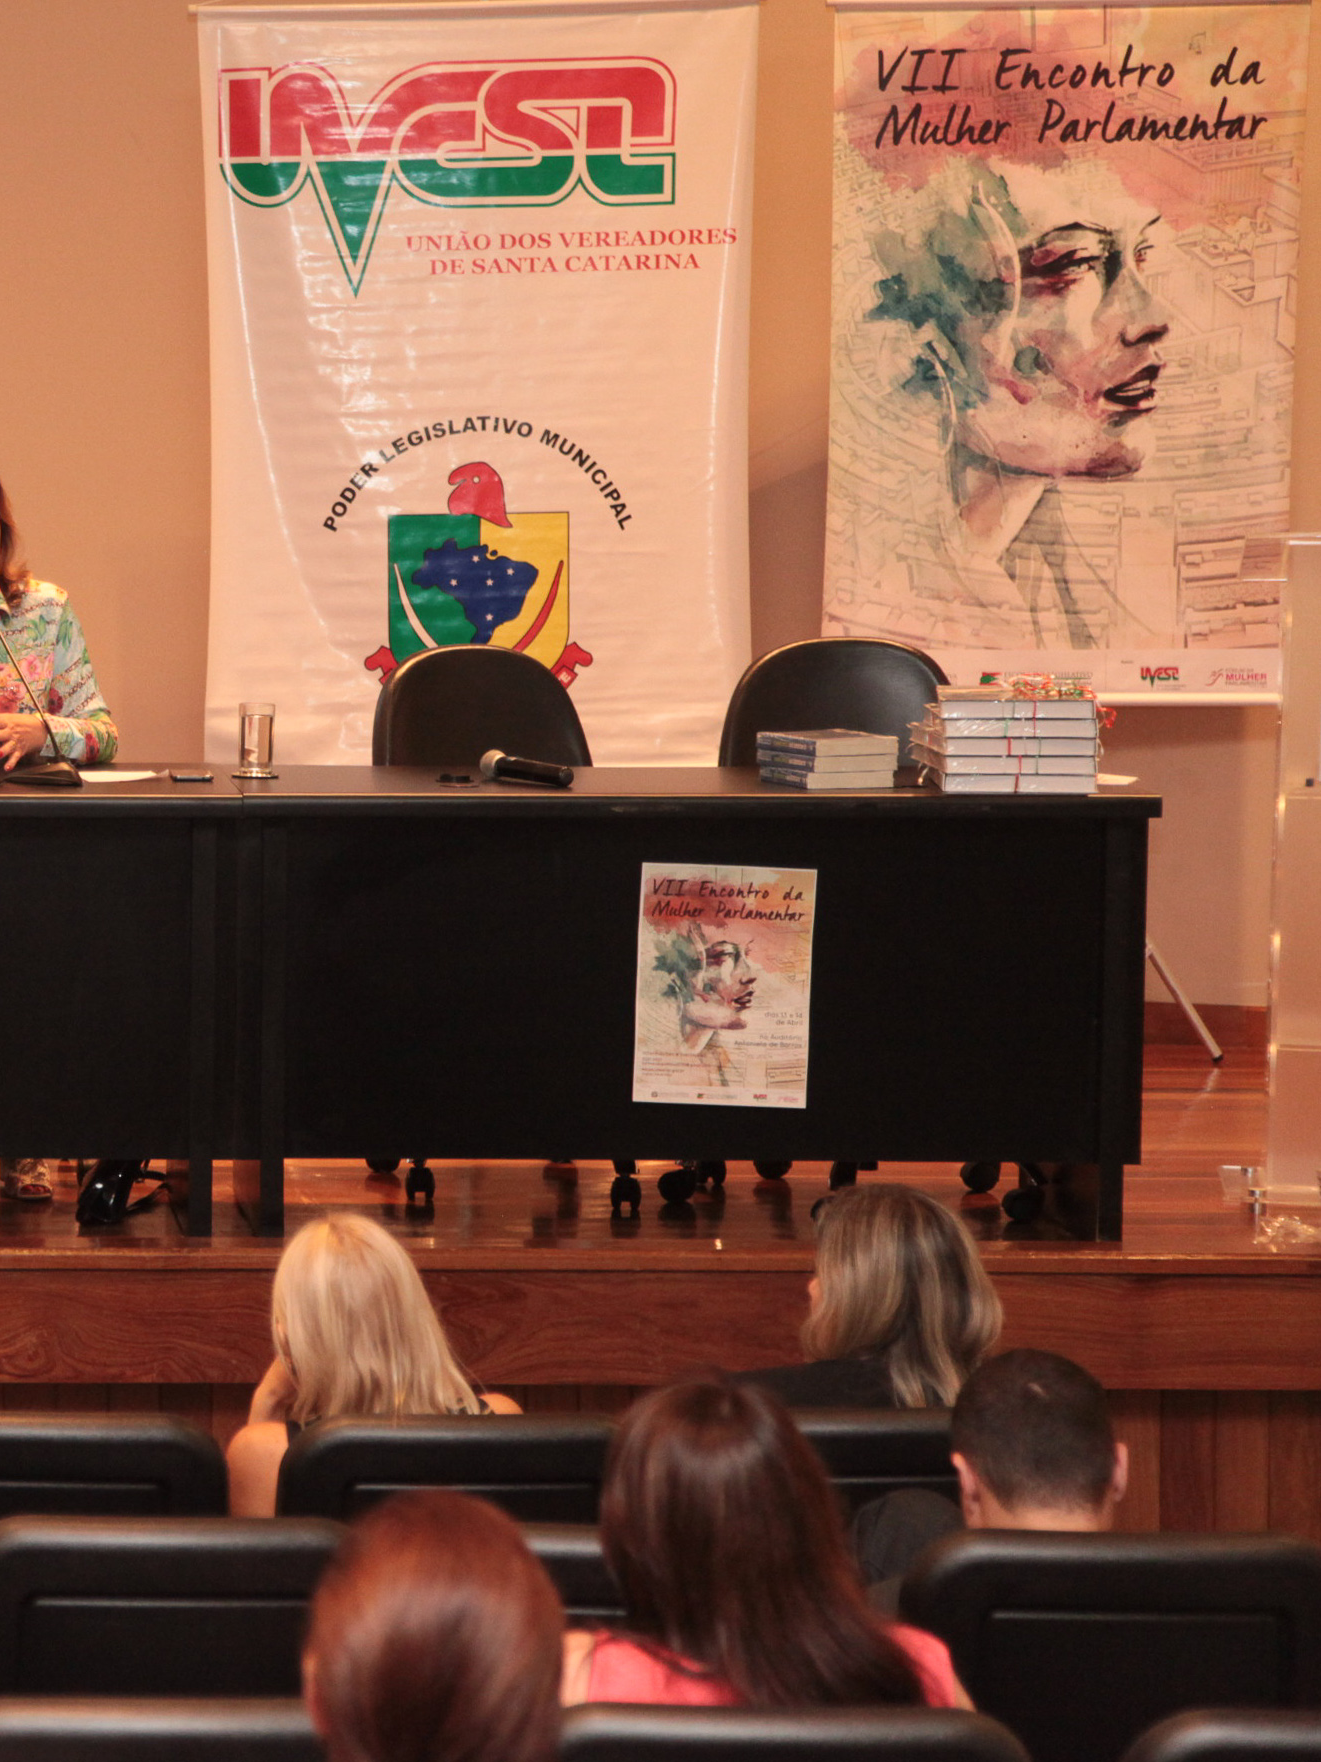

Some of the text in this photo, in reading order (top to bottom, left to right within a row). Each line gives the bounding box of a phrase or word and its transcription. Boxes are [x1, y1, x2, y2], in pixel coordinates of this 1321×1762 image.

[877, 44, 1266, 95] VII Encontro da
[875, 96, 1268, 149] Mulher Parlamentar
[406, 227, 738, 252] UNIÃO DOS VEREADORES
[429, 253, 701, 275] DE SANTA CATARINA
[323, 415, 634, 532] PODER LEGISLATIVO MUNICIPAL
[1225, 673, 1267, 681] MULHER
[653, 878, 805, 901] VII Encontro da
[652, 901, 805, 921] Mulher Parlamentar
